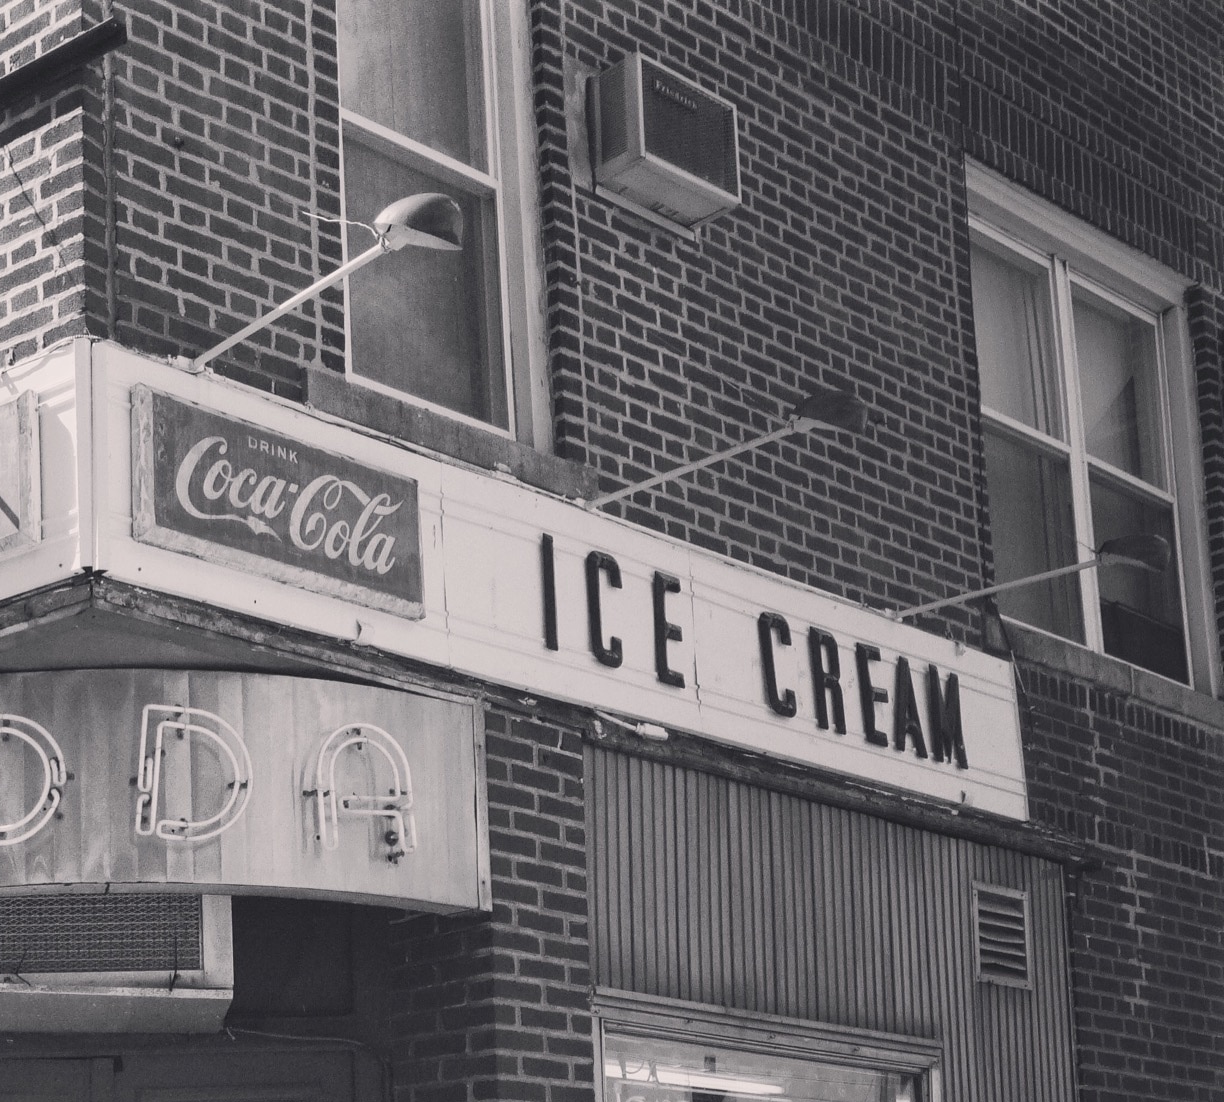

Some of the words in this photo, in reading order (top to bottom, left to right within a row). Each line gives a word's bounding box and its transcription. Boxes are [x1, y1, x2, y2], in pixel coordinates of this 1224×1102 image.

[174, 434, 406, 577] Coca-Cola
[246, 434, 299, 466] DRINK
[542, 532, 685, 689] ICE
[759, 611, 969, 770] CREAM
